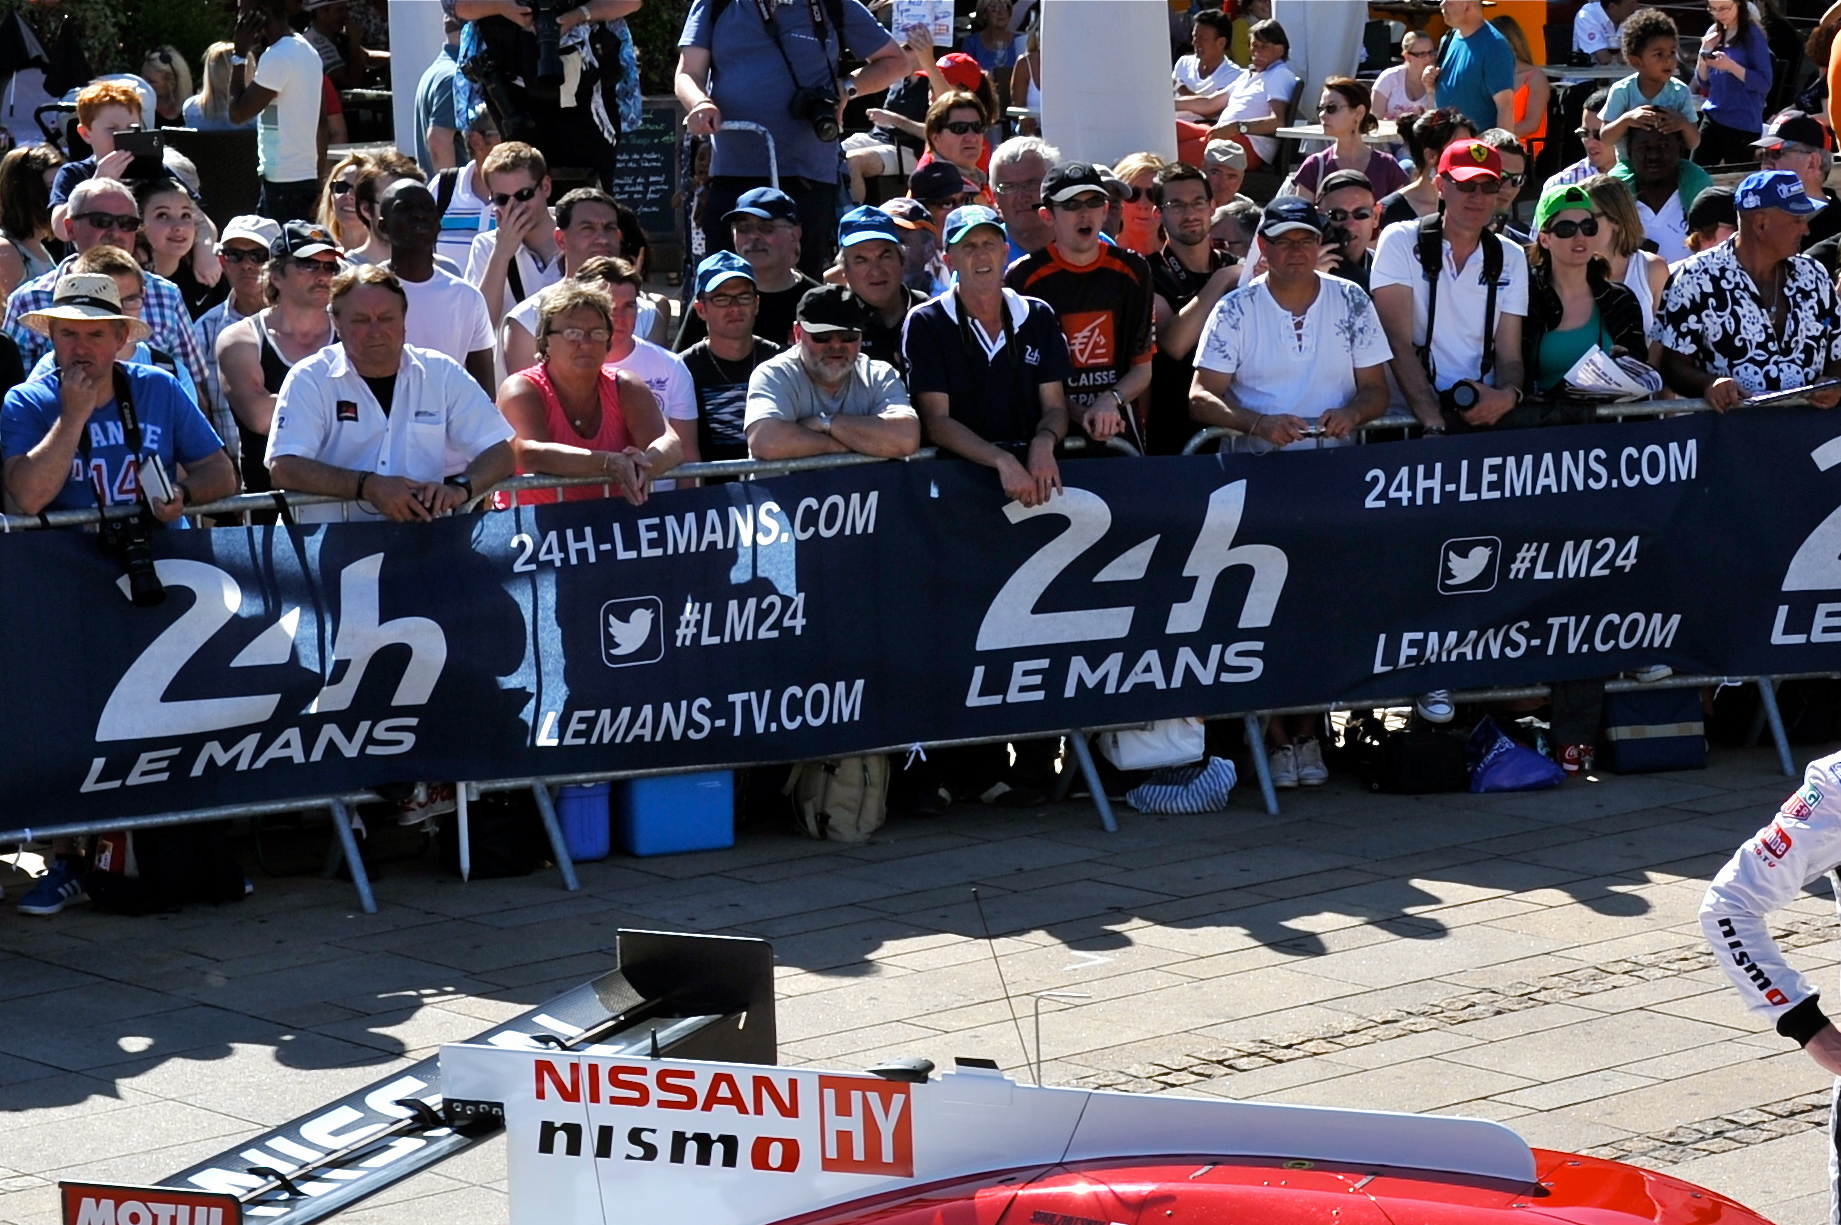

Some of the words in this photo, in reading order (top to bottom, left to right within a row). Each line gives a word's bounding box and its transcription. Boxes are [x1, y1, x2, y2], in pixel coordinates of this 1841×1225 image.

[1067, 369, 1118, 388] CAISSE
[1364, 437, 1699, 510] 24H-LEMANS.COM
[511, 489, 881, 574] 24H-LEMANS.COM
[975, 478, 1289, 652] 24h
[1509, 534, 1641, 581] #LM24
[95, 551, 448, 743] 24h
[675, 593, 808, 649] #LM24
[1372, 612, 1683, 675] LEMANS-TV.COM
[965, 657, 1051, 709] LE
[1064, 640, 1267, 700] MANS
[535, 678, 866, 749] LEMANS-TV.COM
[79, 747, 172, 795] LE
[191, 716, 420, 778] MANS
[1717, 916, 1790, 1006] nismo
[534, 1058, 800, 1119] NISSAN
[824, 1087, 906, 1166] HY
[538, 1120, 800, 1173] nismo
